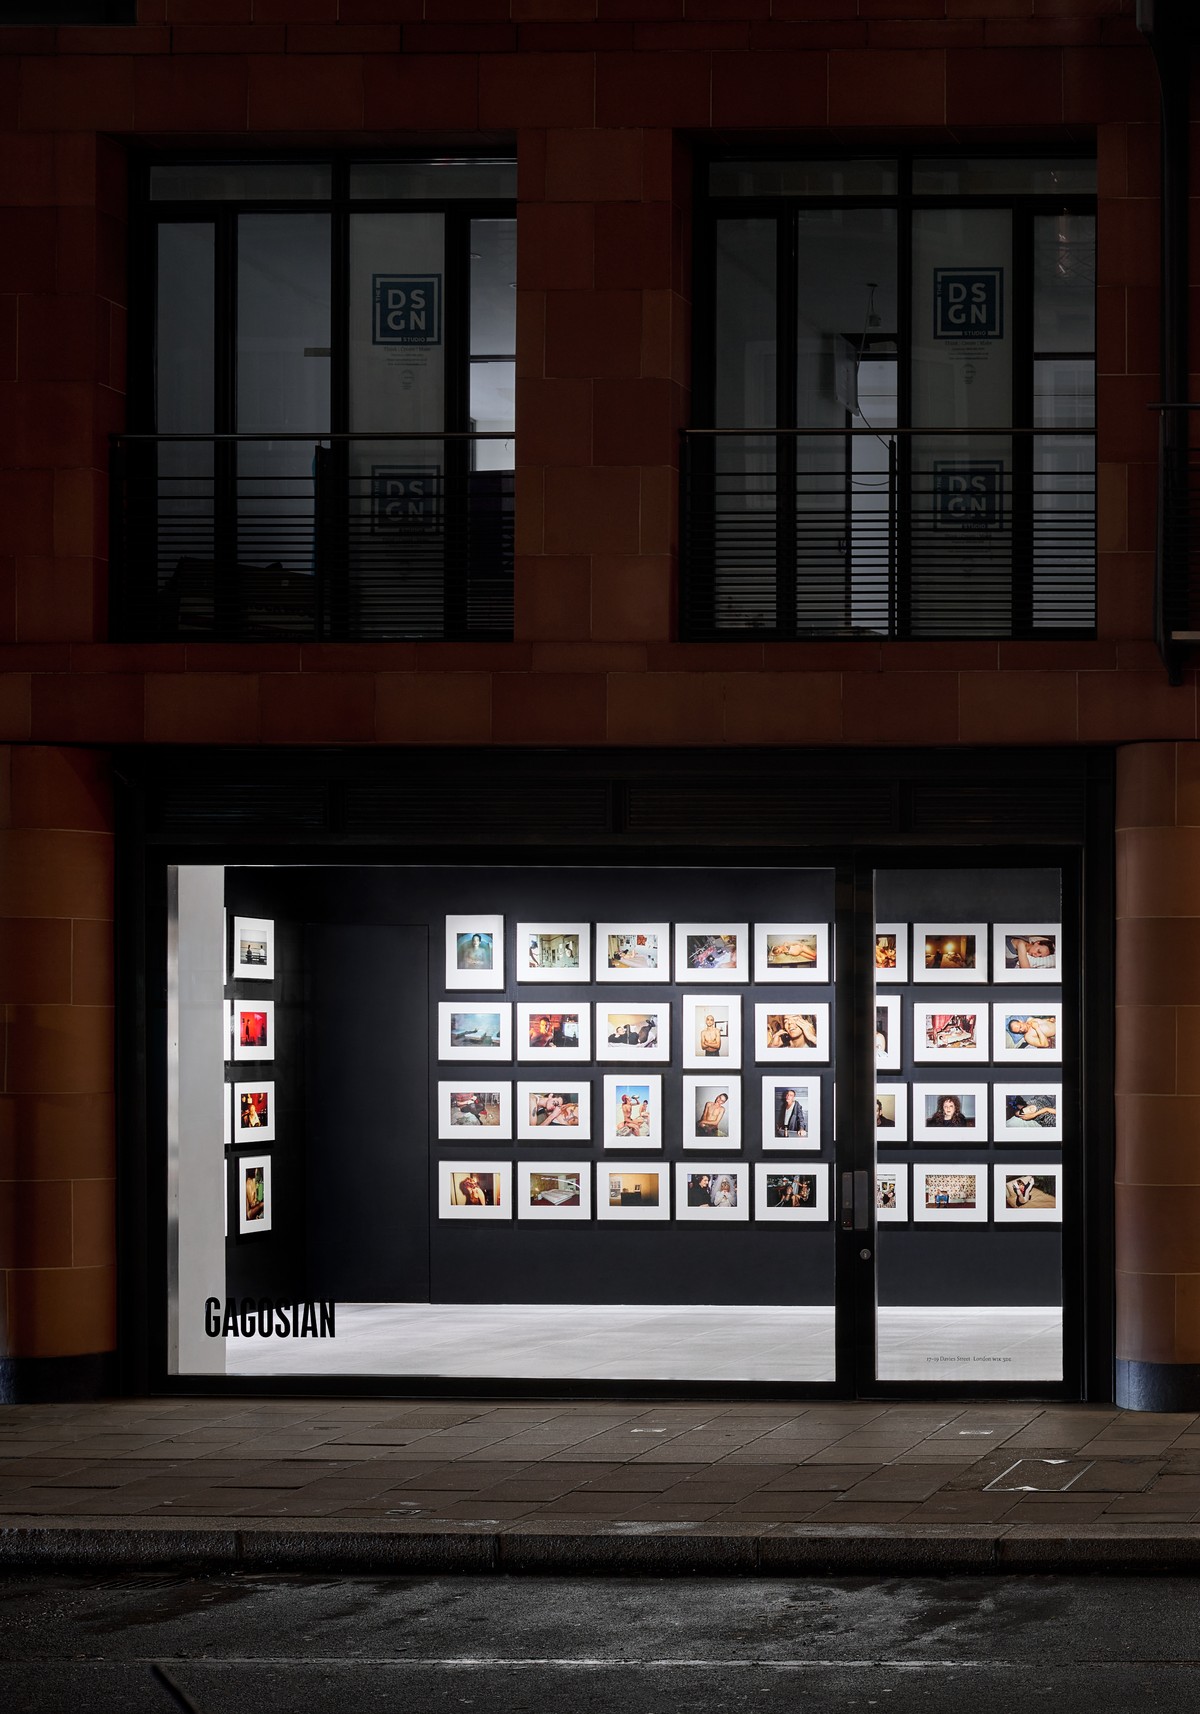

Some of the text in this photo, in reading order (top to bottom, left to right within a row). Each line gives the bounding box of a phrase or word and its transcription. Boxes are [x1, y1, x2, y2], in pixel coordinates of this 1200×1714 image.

[388, 289, 426, 309] DS
[949, 283, 987, 303] DS
[387, 310, 426, 331] GN
[948, 304, 987, 324] GN
[387, 480, 424, 500] DS
[949, 475, 987, 495] DS
[386, 502, 424, 521] GN
[948, 497, 987, 517] GN
[205, 1297, 336, 1338] GAGOSIAN
